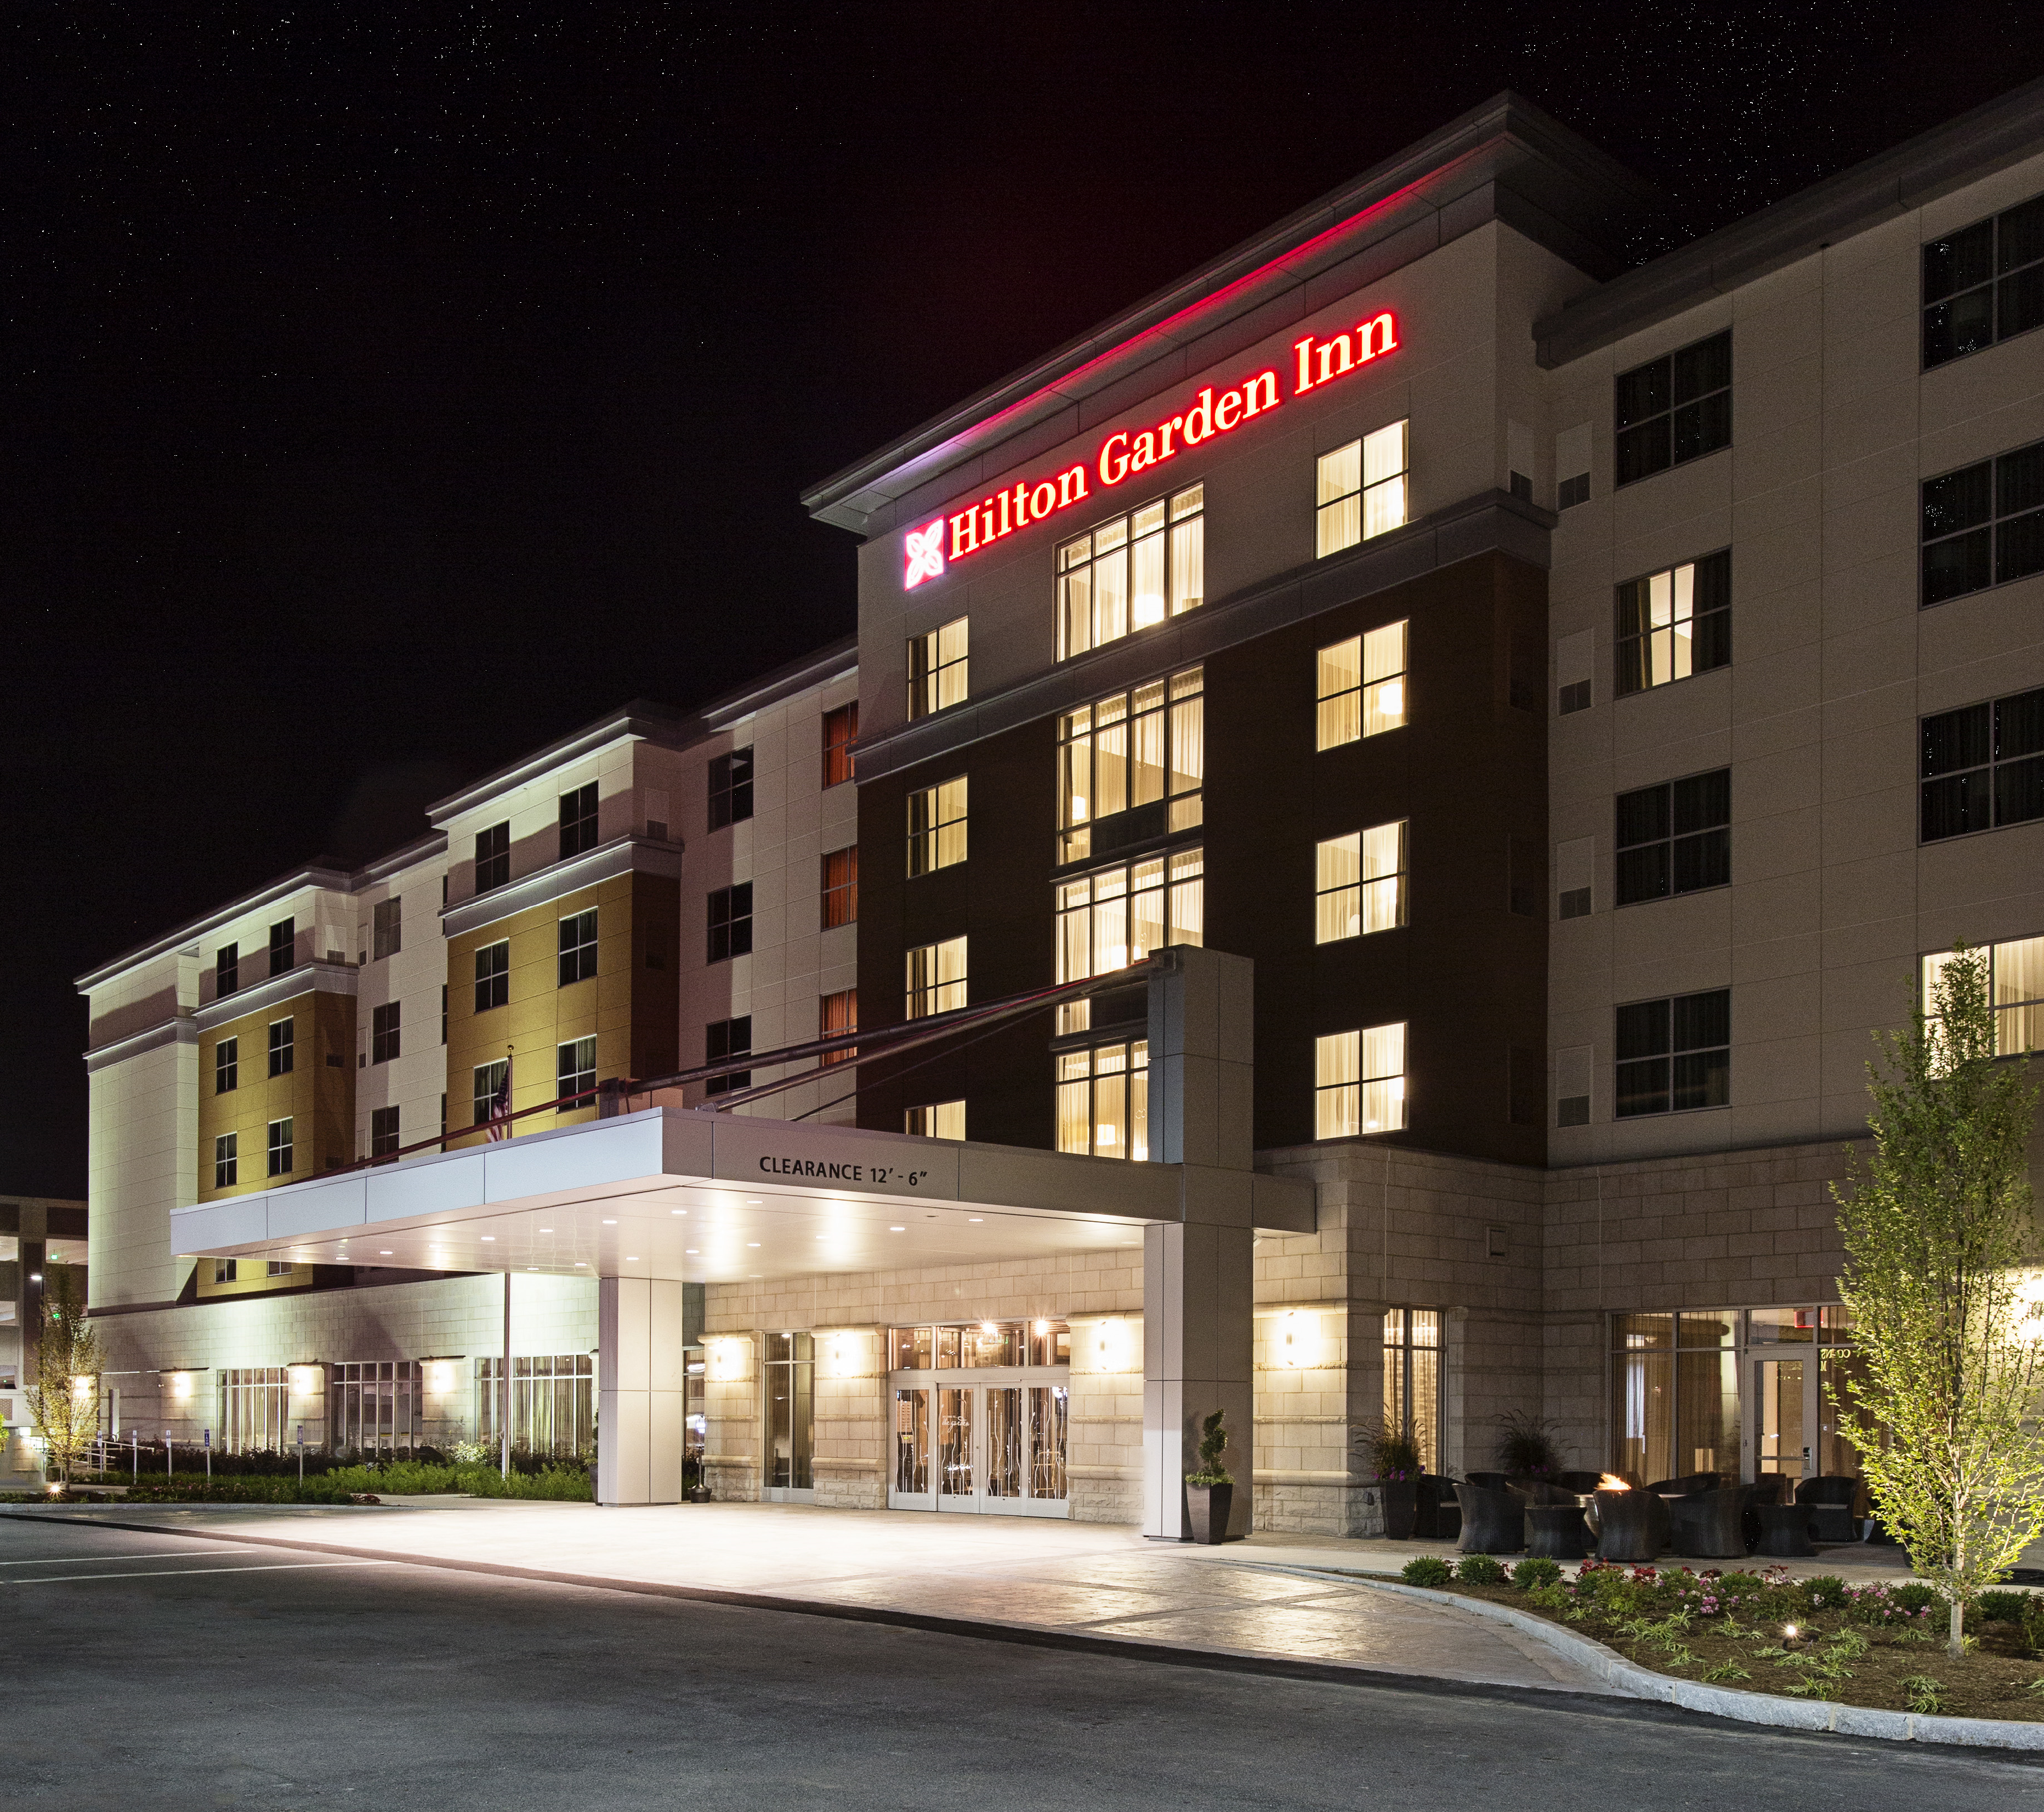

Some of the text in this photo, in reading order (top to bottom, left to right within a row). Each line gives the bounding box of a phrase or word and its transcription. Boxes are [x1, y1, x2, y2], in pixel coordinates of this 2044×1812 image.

[948, 312, 1398, 562] Hilton Garden Inn
[759, 1156, 863, 1181] CLEARANCE
